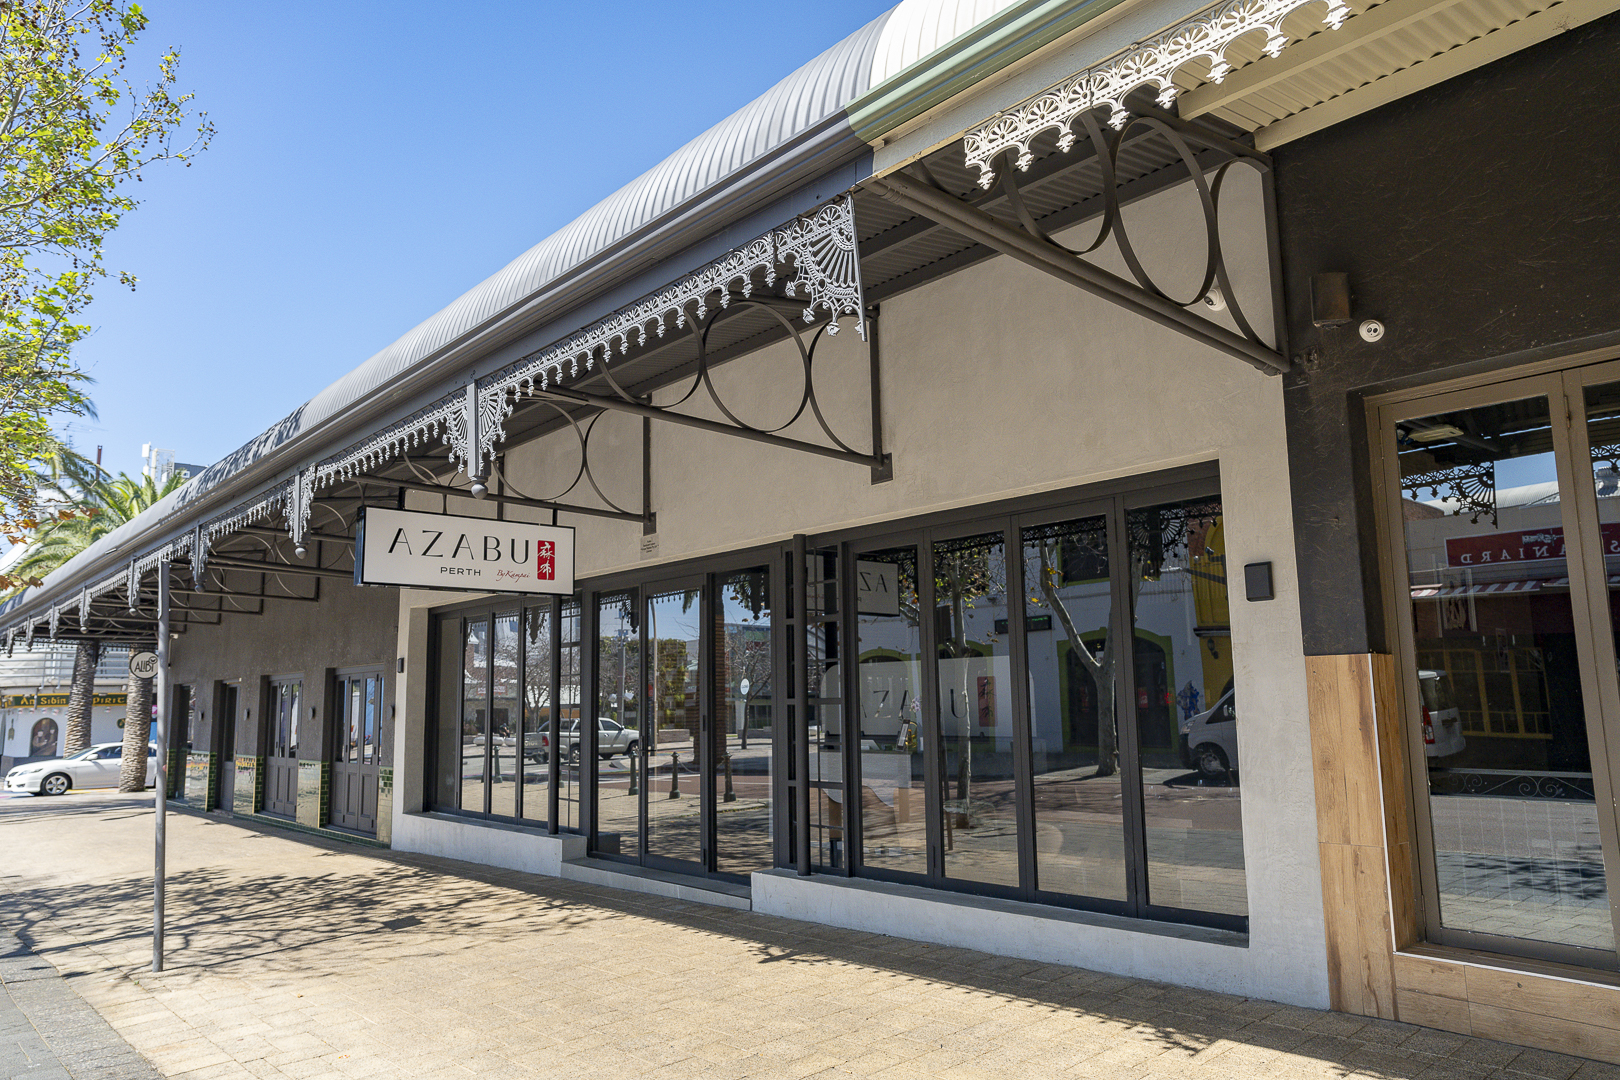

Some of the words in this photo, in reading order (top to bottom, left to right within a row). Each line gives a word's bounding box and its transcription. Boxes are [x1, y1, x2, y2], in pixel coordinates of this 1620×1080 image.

[388, 528, 530, 564] AZABU
[440, 567, 481, 577] PERTH
[495, 569, 506, 581] By
[505, 571, 530, 583] Kampai
